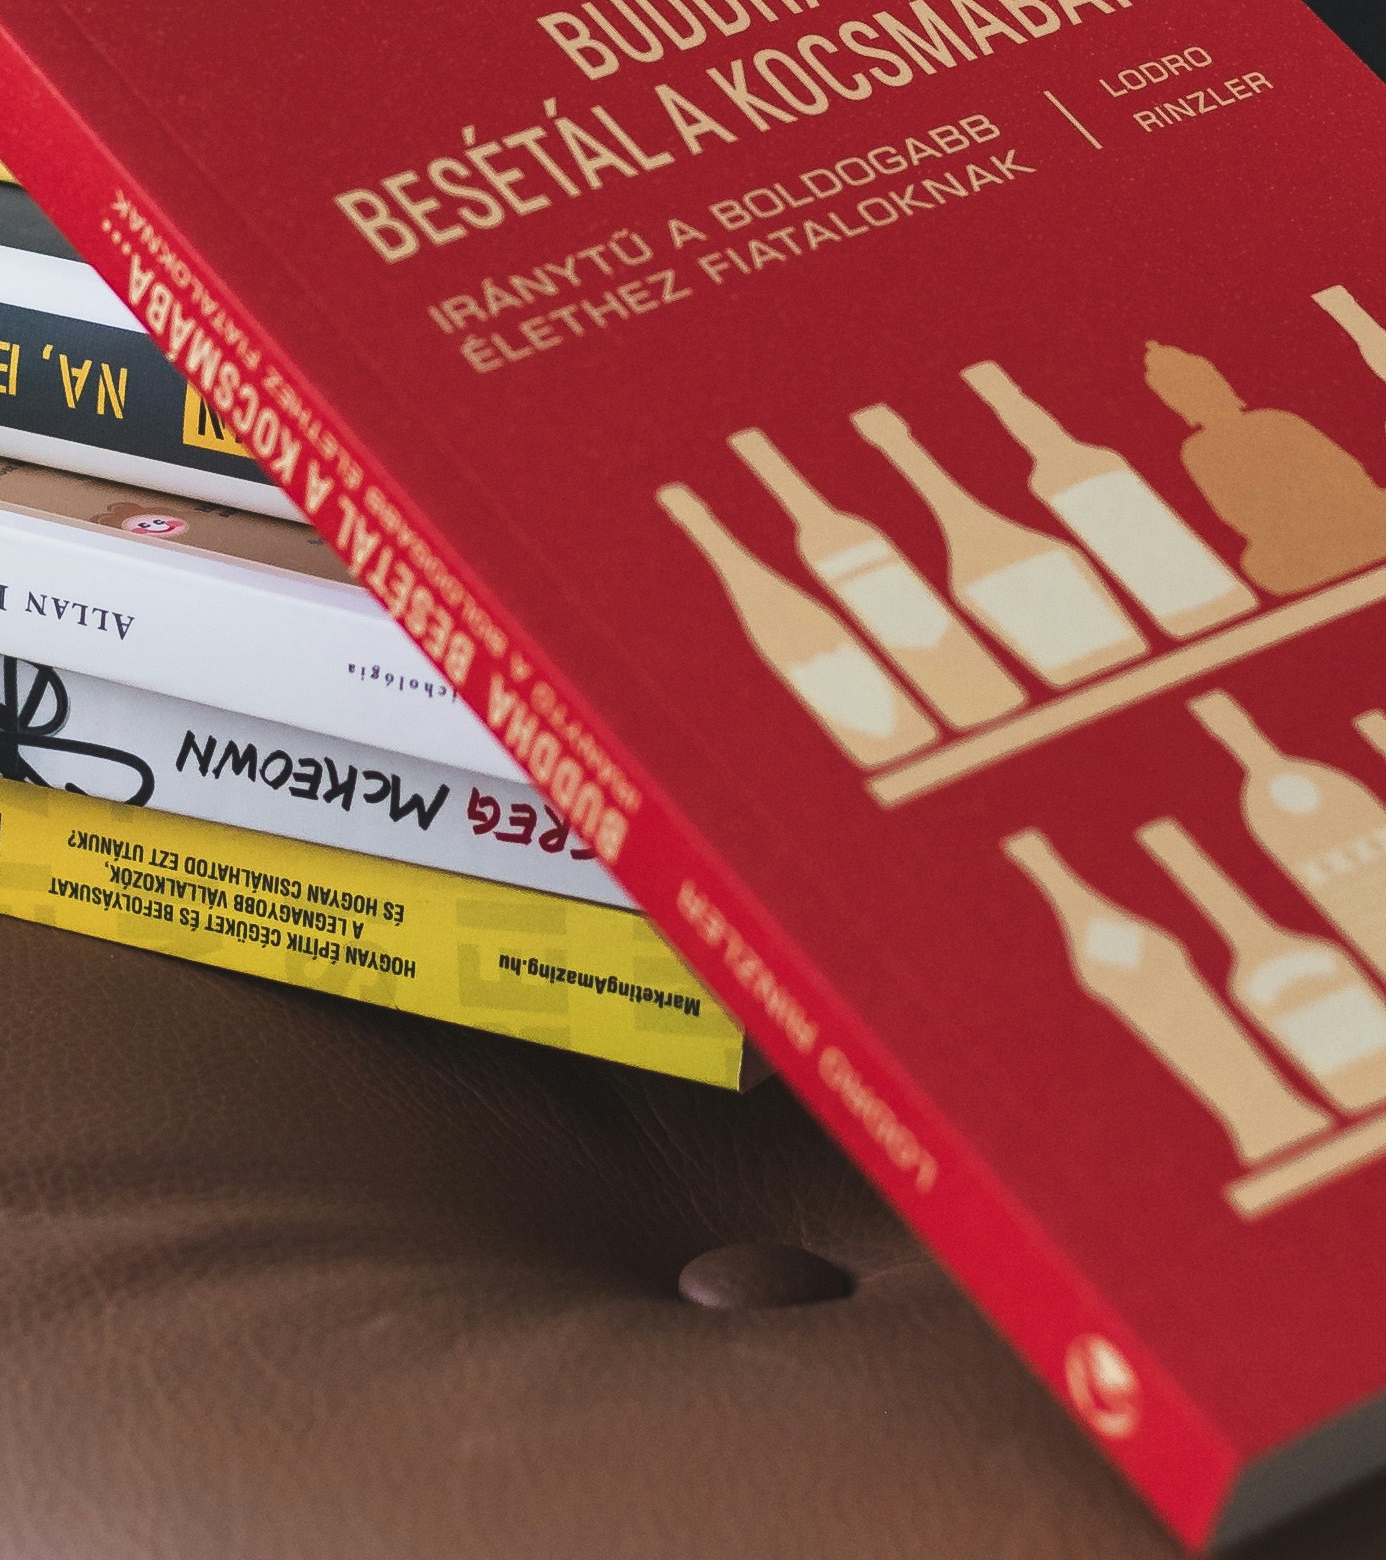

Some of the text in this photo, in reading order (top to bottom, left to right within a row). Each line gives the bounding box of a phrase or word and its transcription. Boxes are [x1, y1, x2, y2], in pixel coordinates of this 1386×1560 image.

[1099, 45, 1213, 98] LODRO
[1132, 71, 1274, 134] RINZLER
[333, 97, 675, 264] BESÉTÁL
[654, 83, 739, 156] A
[667, 217, 708, 250] A
[709, 114, 1001, 231] BOLDOGABB
[460, 149, 1037, 374] ÉLETHEZ FIATALOKNAK
[42, 344, 128, 420] NA,
[305, 460, 334, 514] A
[24, 589, 136, 641] ALLAN
[175, 729, 598, 861] REG McKEOWN
[488, 674, 629, 865] BUDDHA
[67, 829, 406, 927] ÉS HOGYAN CSINÁLHATOD EZT UTÁNUK?
[103, 861, 365, 940] A LEGNAGYOBB VÁLLALKOZÓK,
[47, 877, 417, 979] HOGYAN ÉPÍTIK CÉGÜKET ÉS BEFOLYÁSUKAT
[498, 954, 702, 1017] MarketingAmazing.hu
